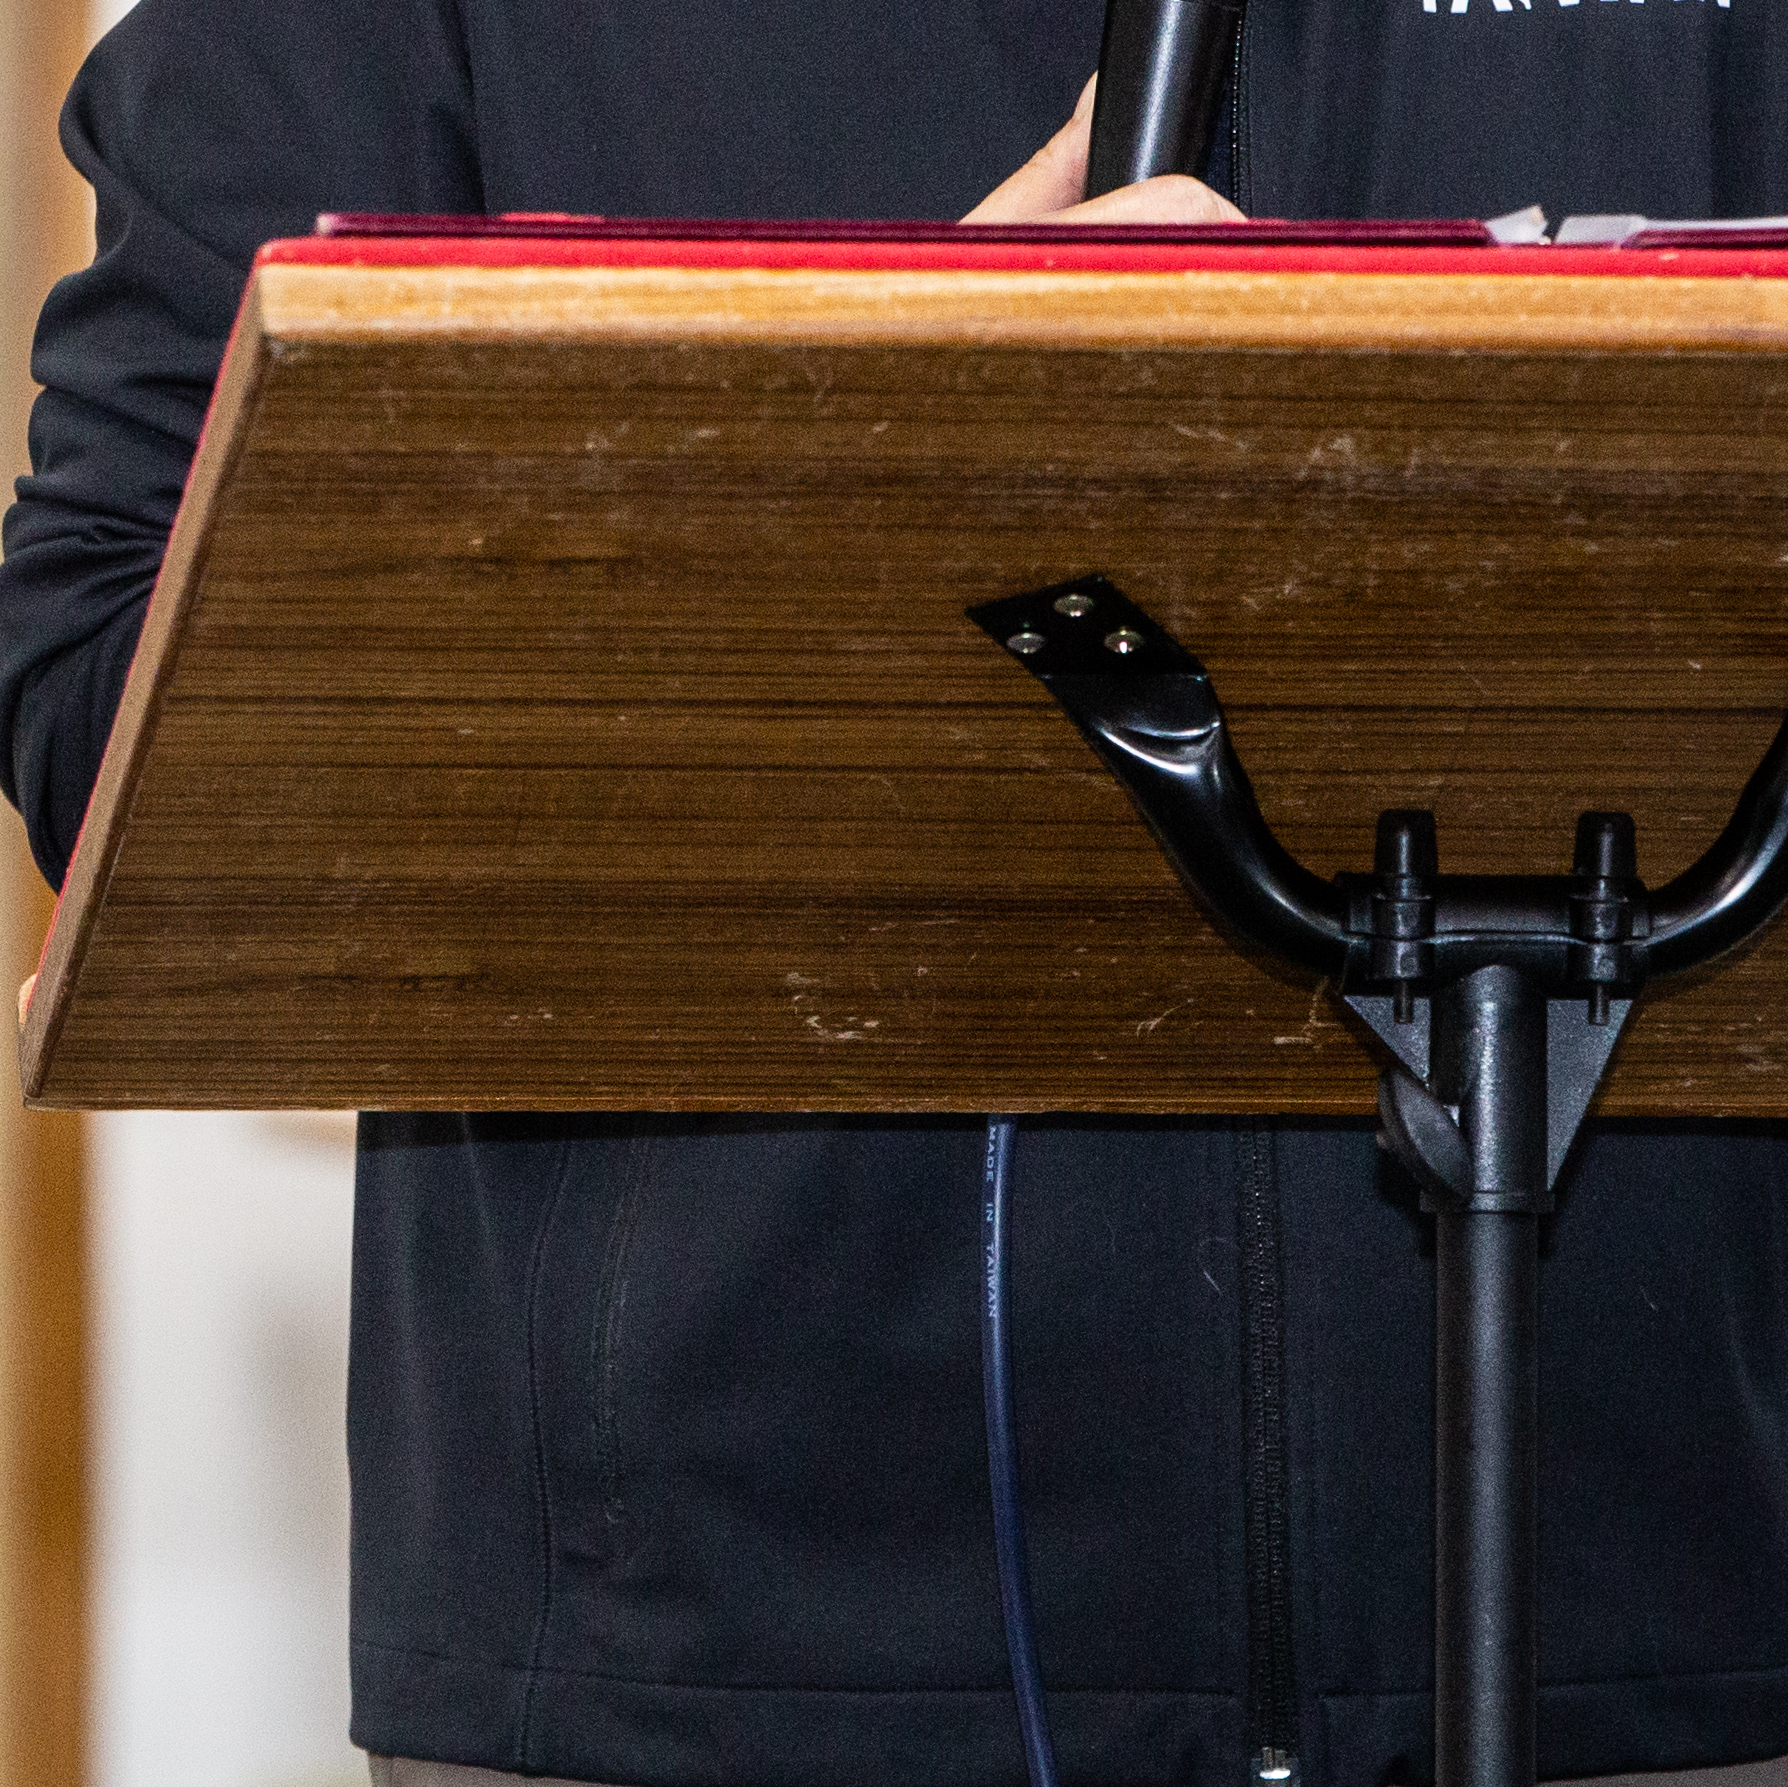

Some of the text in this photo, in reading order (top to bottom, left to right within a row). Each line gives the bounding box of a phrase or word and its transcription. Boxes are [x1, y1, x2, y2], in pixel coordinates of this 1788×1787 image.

[985, 1126, 998, 1317] MADE IN TAIWAN
